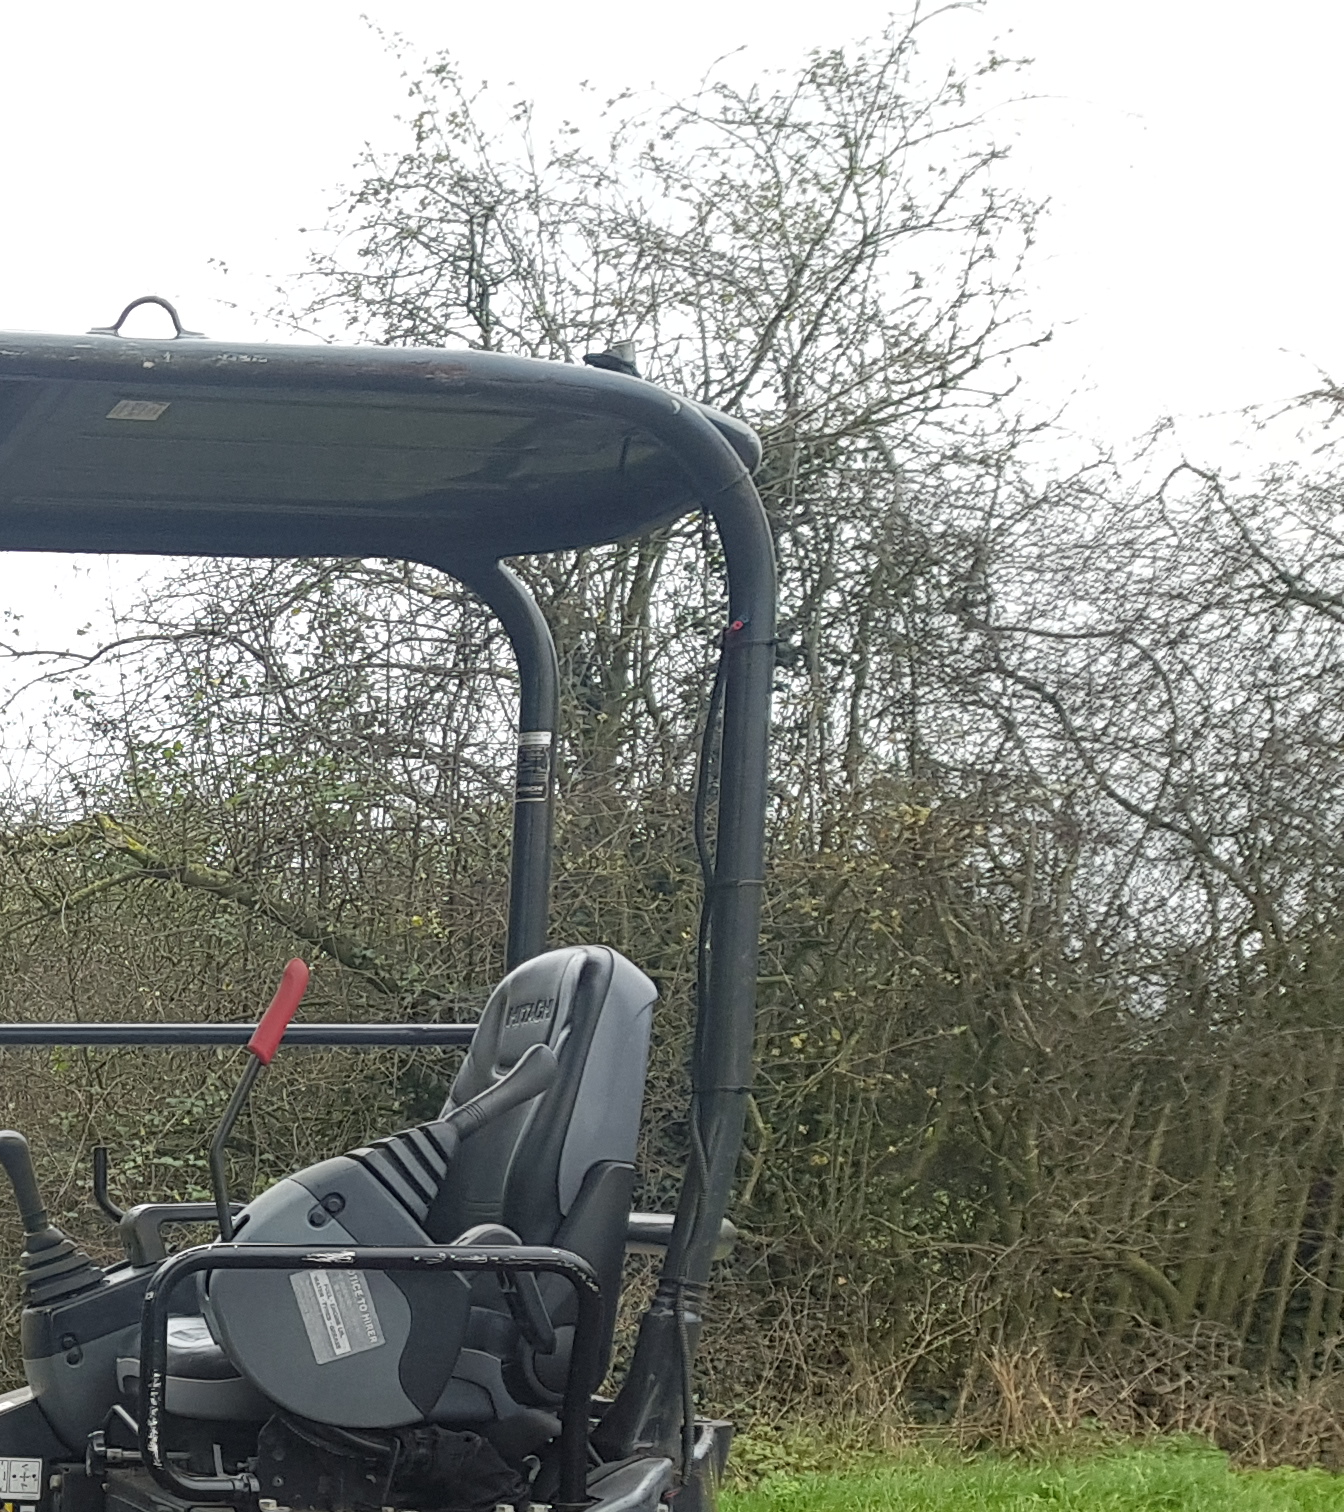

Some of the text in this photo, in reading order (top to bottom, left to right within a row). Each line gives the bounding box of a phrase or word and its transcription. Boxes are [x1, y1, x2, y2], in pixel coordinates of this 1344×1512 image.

[505, 998, 555, 1029] HITACH
[347, 1269, 378, 1344] OTICE TO HIRER
